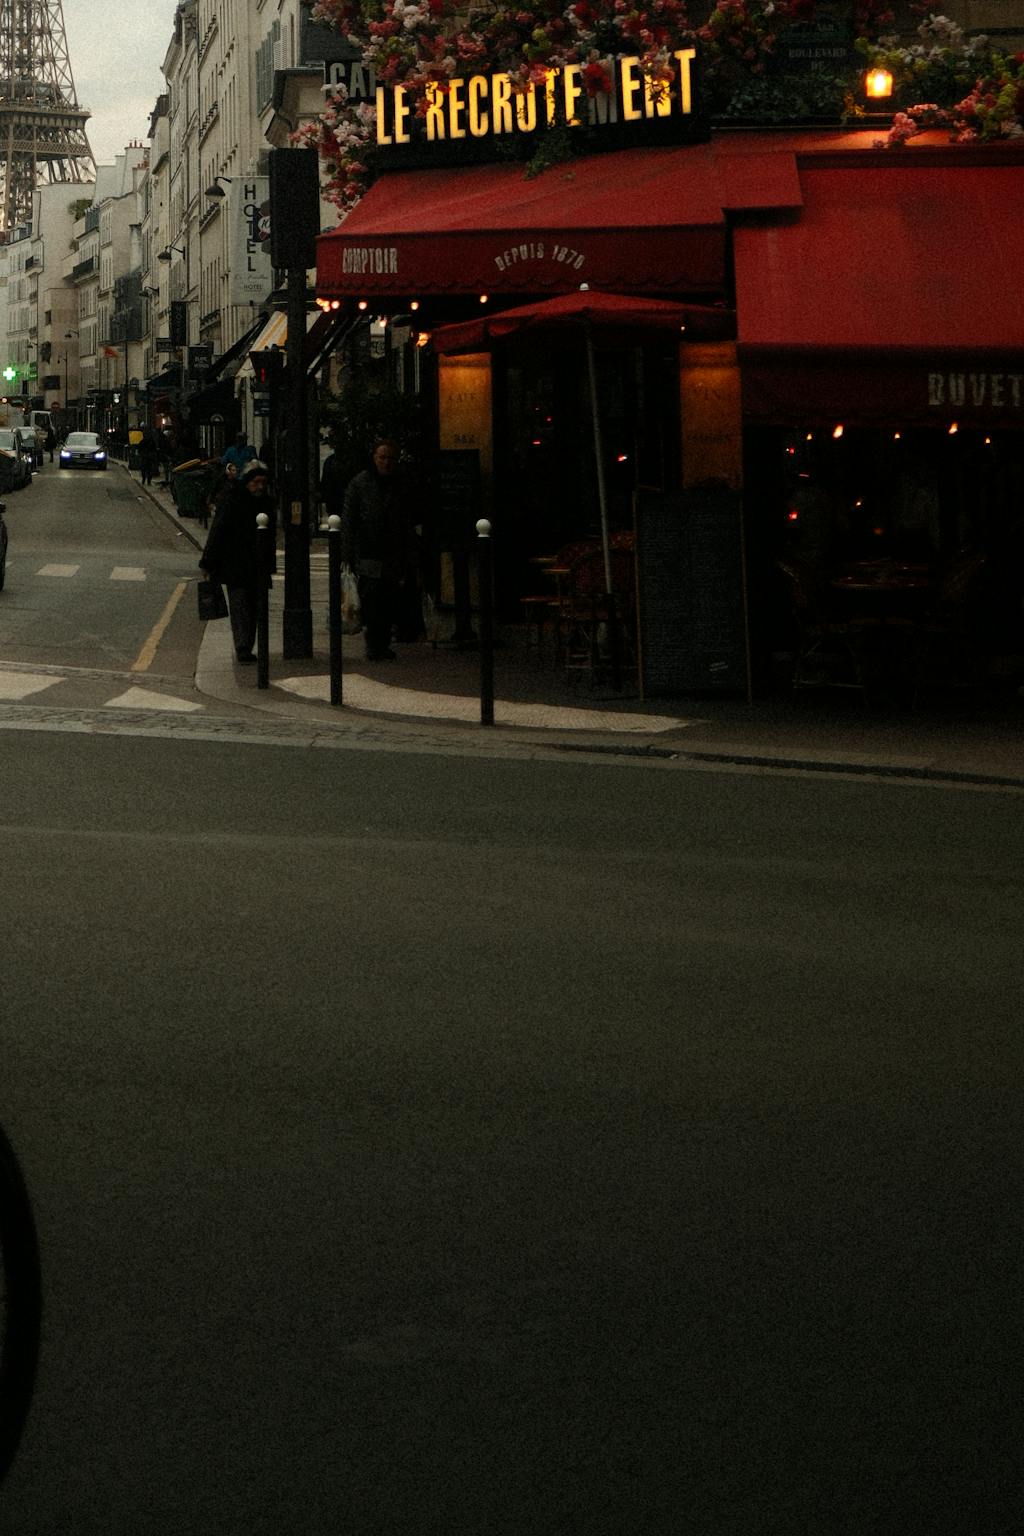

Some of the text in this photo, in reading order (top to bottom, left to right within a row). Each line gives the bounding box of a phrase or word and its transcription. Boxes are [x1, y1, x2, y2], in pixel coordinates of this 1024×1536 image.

[376, 84, 411, 146] LE
[342, 247, 399, 274] COMPTOIR
[493, 242, 545, 272] DEPUIS
